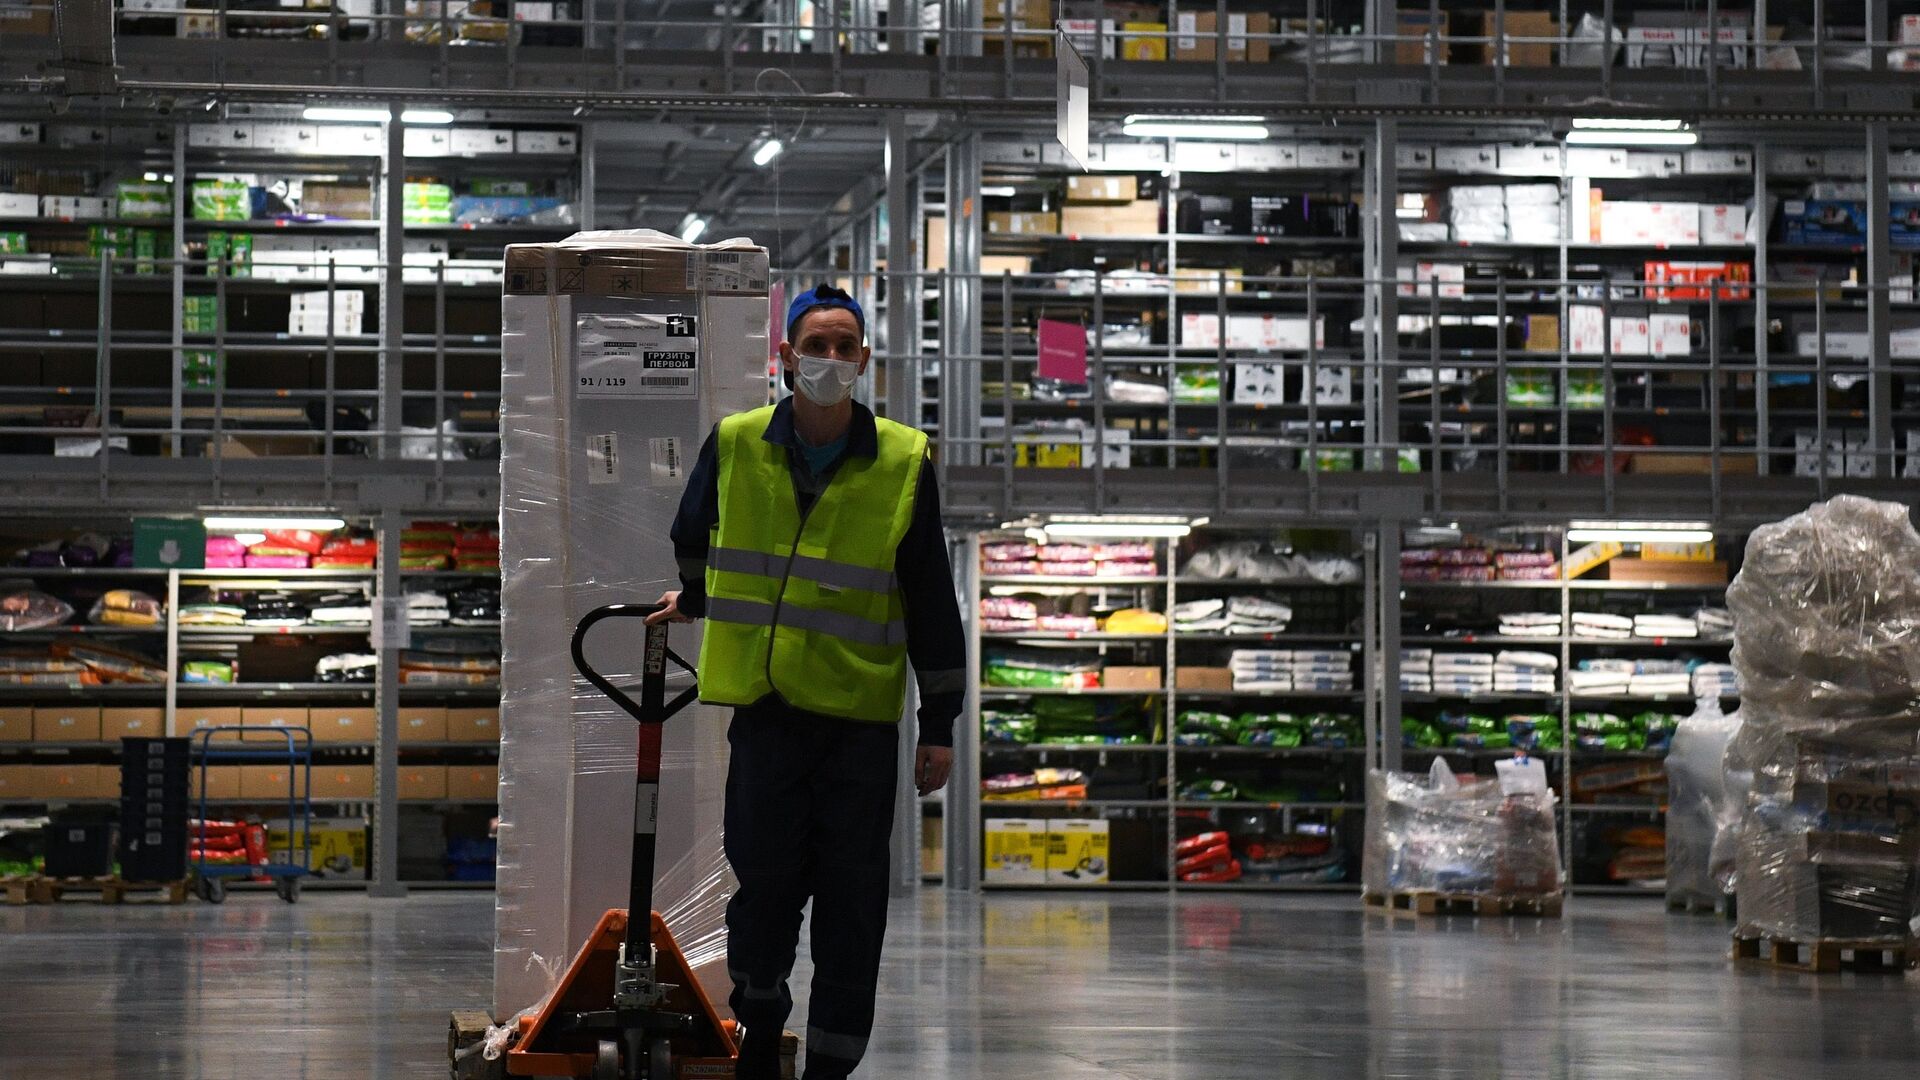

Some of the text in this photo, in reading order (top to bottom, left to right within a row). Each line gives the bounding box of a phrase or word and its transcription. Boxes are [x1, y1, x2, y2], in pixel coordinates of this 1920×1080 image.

[648, 352, 690, 360] ГРУЗИТЬ
[650, 360, 689, 368] ПЕРВОЙ
[581, 378, 626, 386] 91 / 119
